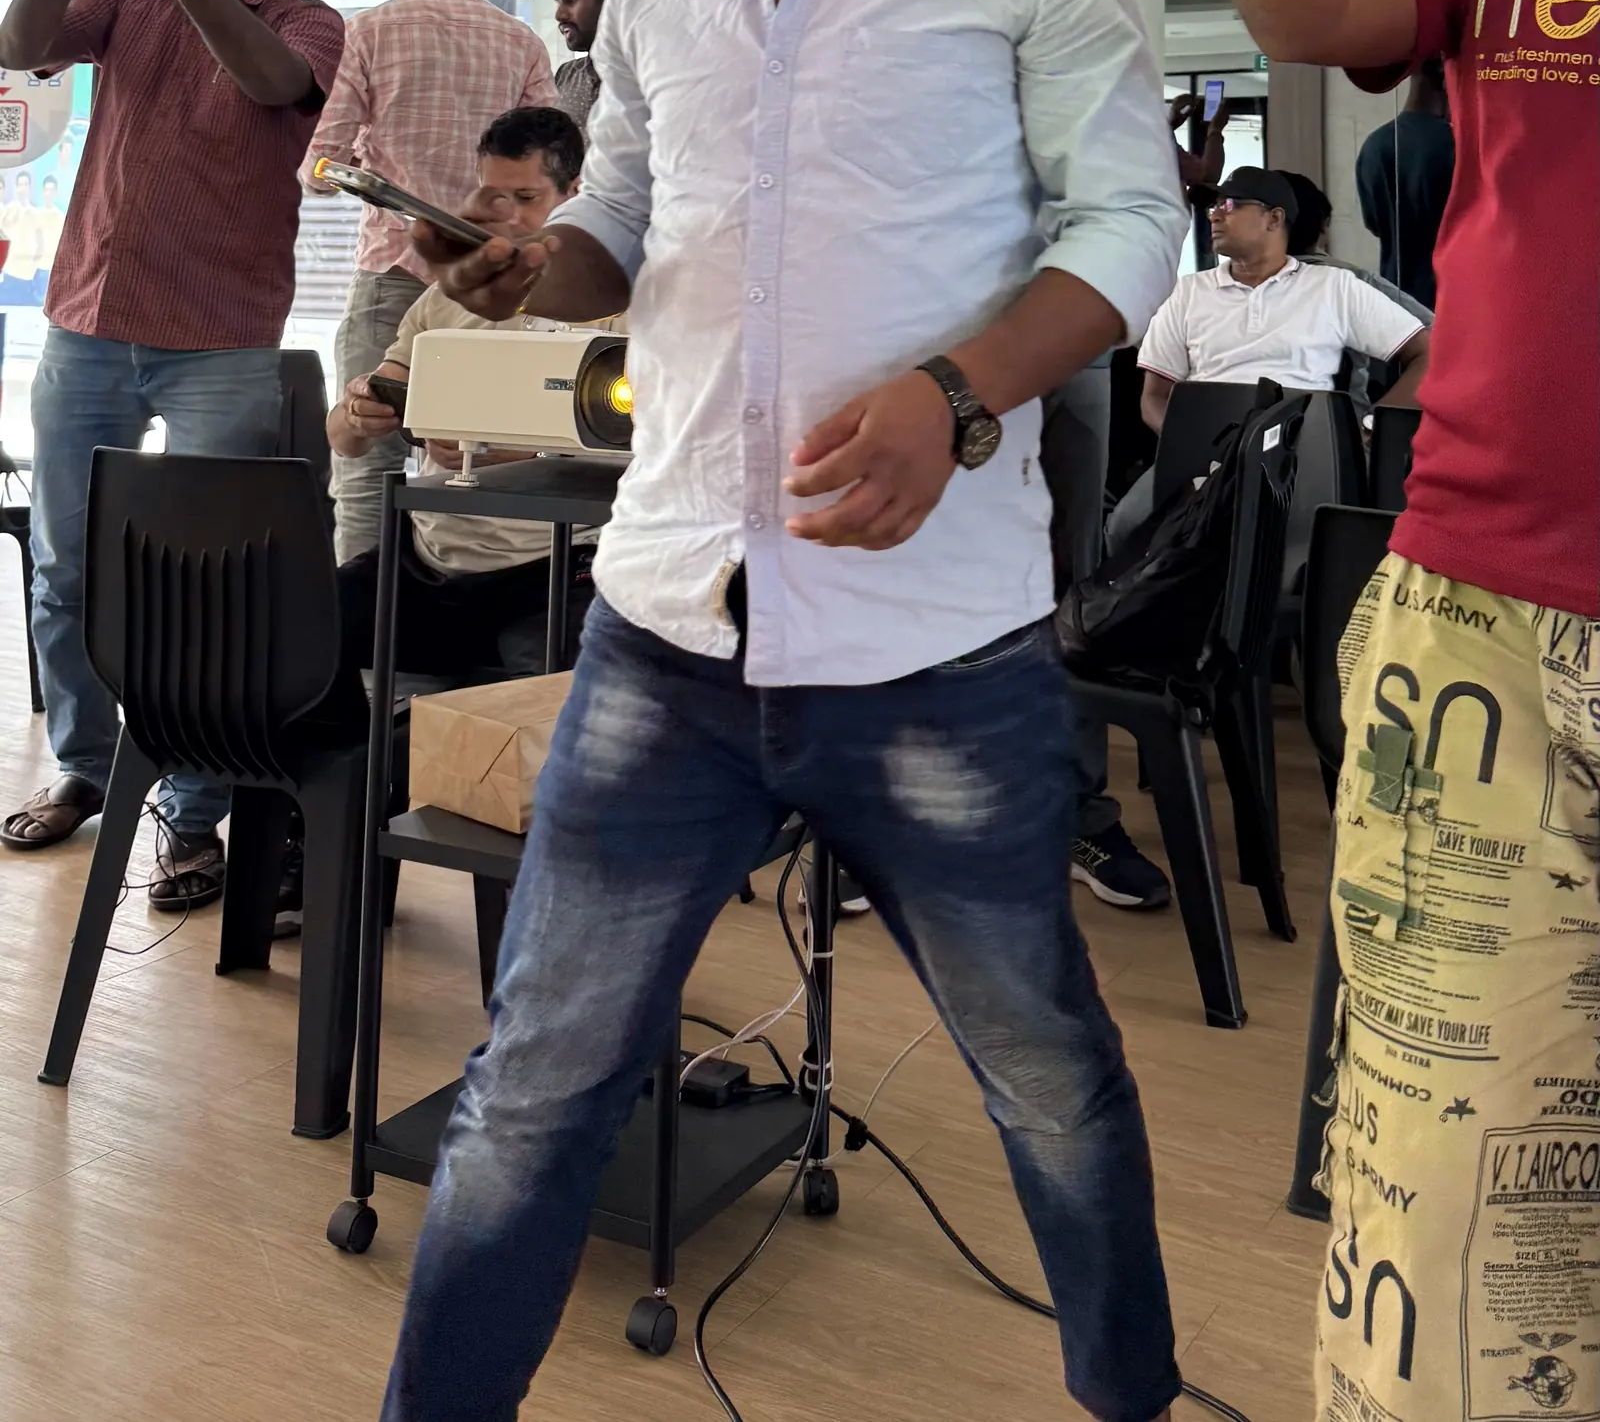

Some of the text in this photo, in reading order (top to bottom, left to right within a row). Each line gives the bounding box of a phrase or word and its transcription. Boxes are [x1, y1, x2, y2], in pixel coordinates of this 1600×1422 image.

[1516, 46, 1593, 65] freshmen
[1542, 66, 1583, 85] love,
[1437, 830, 1527, 864] SAVE YOUR LIFE
[1405, 1011, 1435, 1038] SAVE
[1437, 1019, 1471, 1044] YOUR
[1468, 1023, 1493, 1045] LIFE
[1354, 1087, 1379, 1146] US
